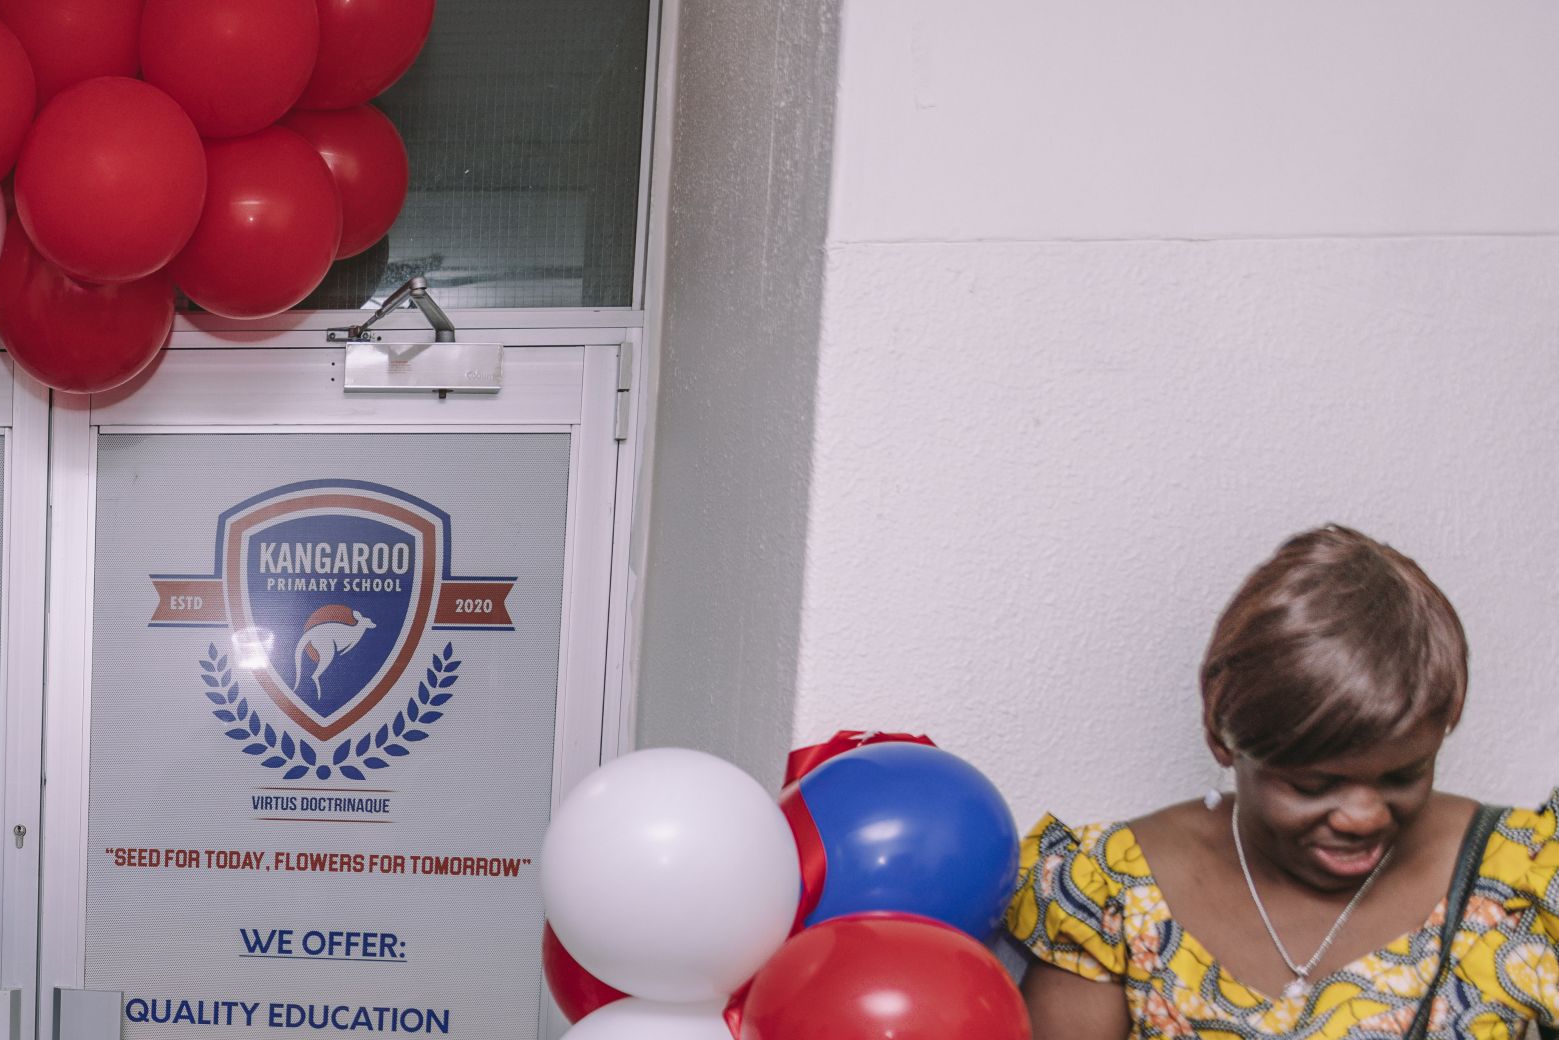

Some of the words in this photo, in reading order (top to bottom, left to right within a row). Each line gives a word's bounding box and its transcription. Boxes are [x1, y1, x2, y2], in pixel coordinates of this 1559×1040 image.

[259, 542, 410, 575] KANGAROO
[266, 577, 336, 592] PRIMARY
[343, 578, 402, 593] SCHOOL
[170, 595, 203, 611] ESTD
[455, 598, 493, 613] 2020
[251, 795, 298, 812] VIRTUS
[300, 796, 391, 814] DOCTRINAQUE
[164, 849, 200, 869] FOR
[205, 850, 271, 872] TODAY,
[274, 852, 365, 872] FLOWERS
[369, 854, 406, 875] FOR
[240, 928, 294, 955] WE
[302, 930, 407, 959] OFFER:
[125, 998, 261, 1026] QUALITY
[268, 1003, 450, 1034] EDUCATION
